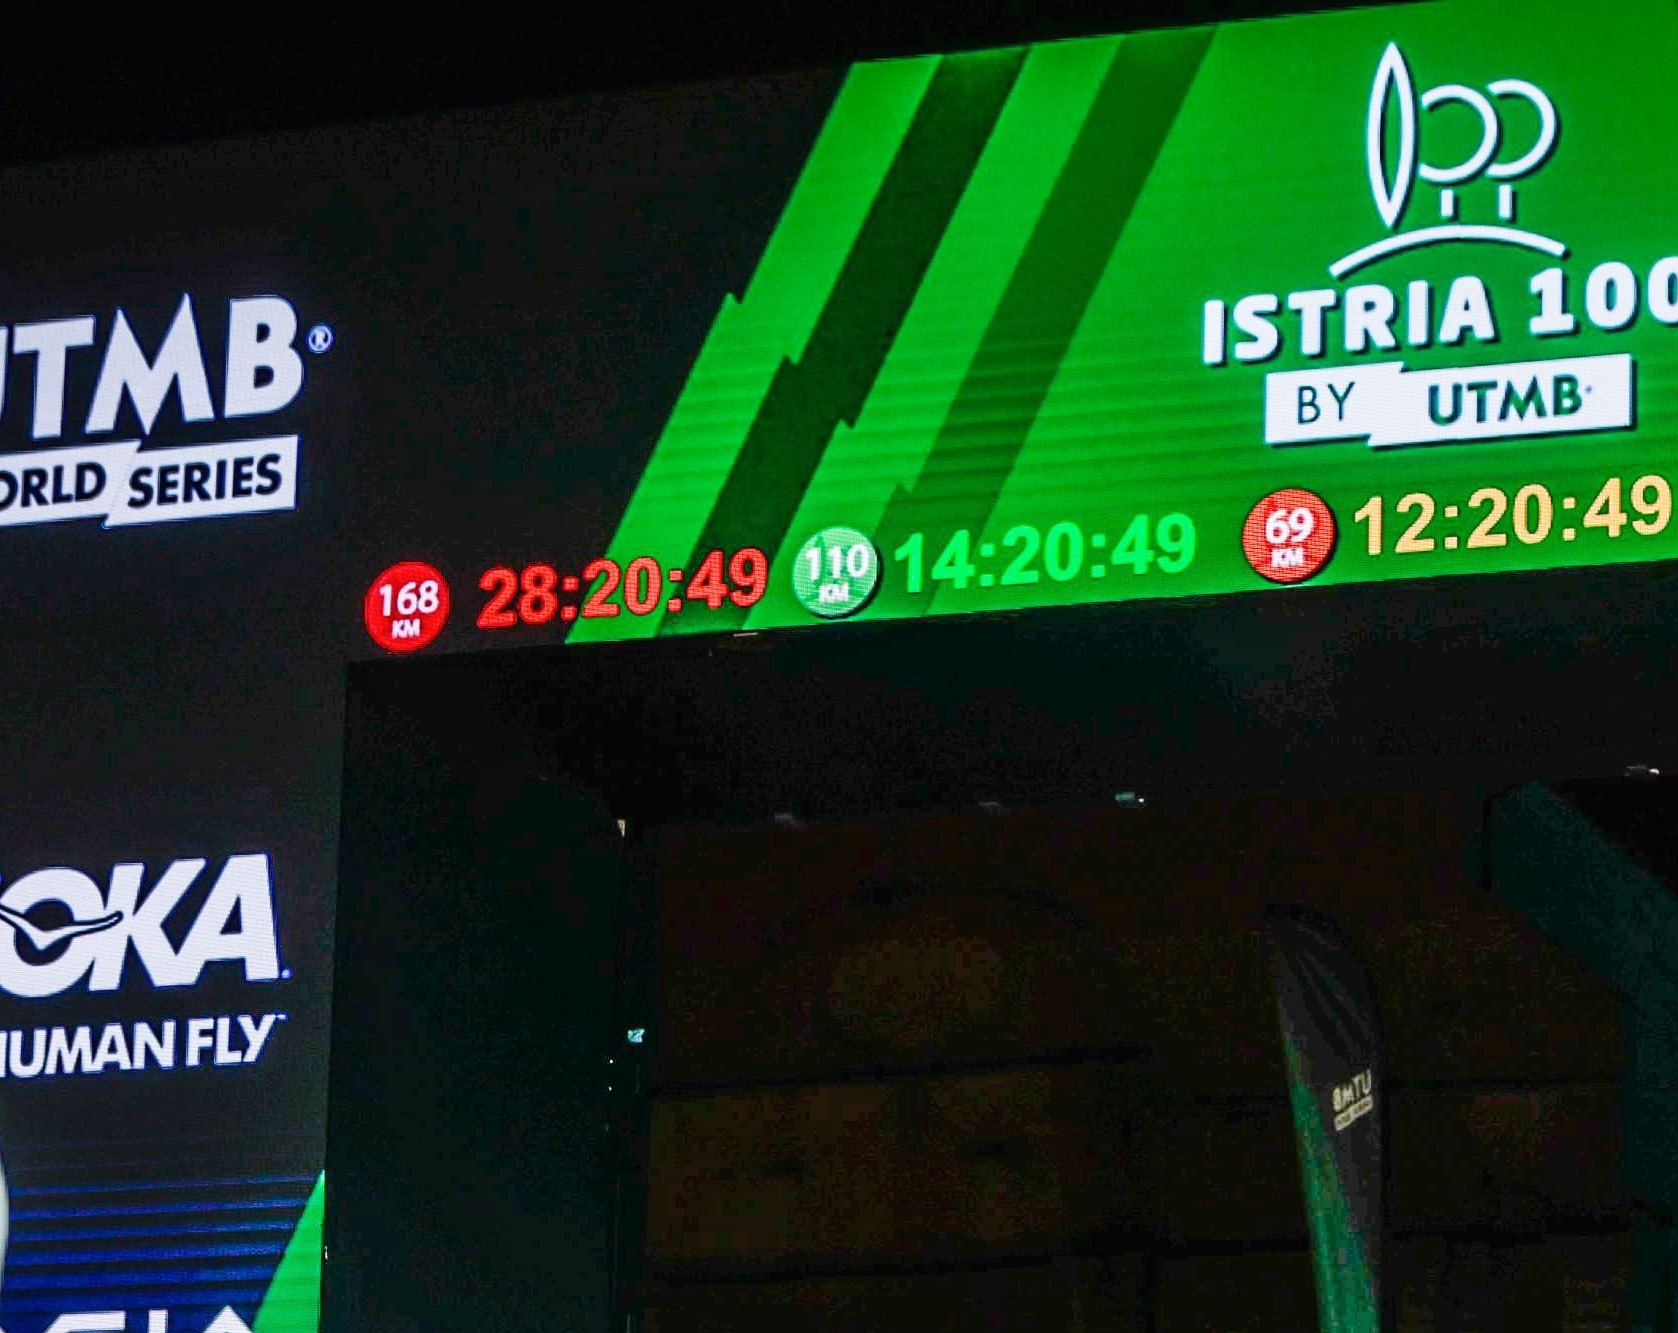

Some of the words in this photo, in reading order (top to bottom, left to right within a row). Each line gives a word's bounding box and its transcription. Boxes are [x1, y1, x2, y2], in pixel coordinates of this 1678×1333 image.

[1203, 276, 1497, 365] ISTRIA
[1296, 381, 1356, 425] BY
[128, 454, 282, 508] SERIES
[1263, 508, 1315, 544] 69
[1354, 474, 1673, 556] 12:20:49
[802, 544, 869, 577] 110
[894, 513, 1196, 594] 14:20:49
[1271, 548, 1304, 569] KM
[379, 580, 439, 618] 168
[475, 547, 768, 628] 28:20:49
[818, 582, 850, 603] KM
[391, 618, 421, 639] KM
[186, 1013, 280, 1067] FLY
